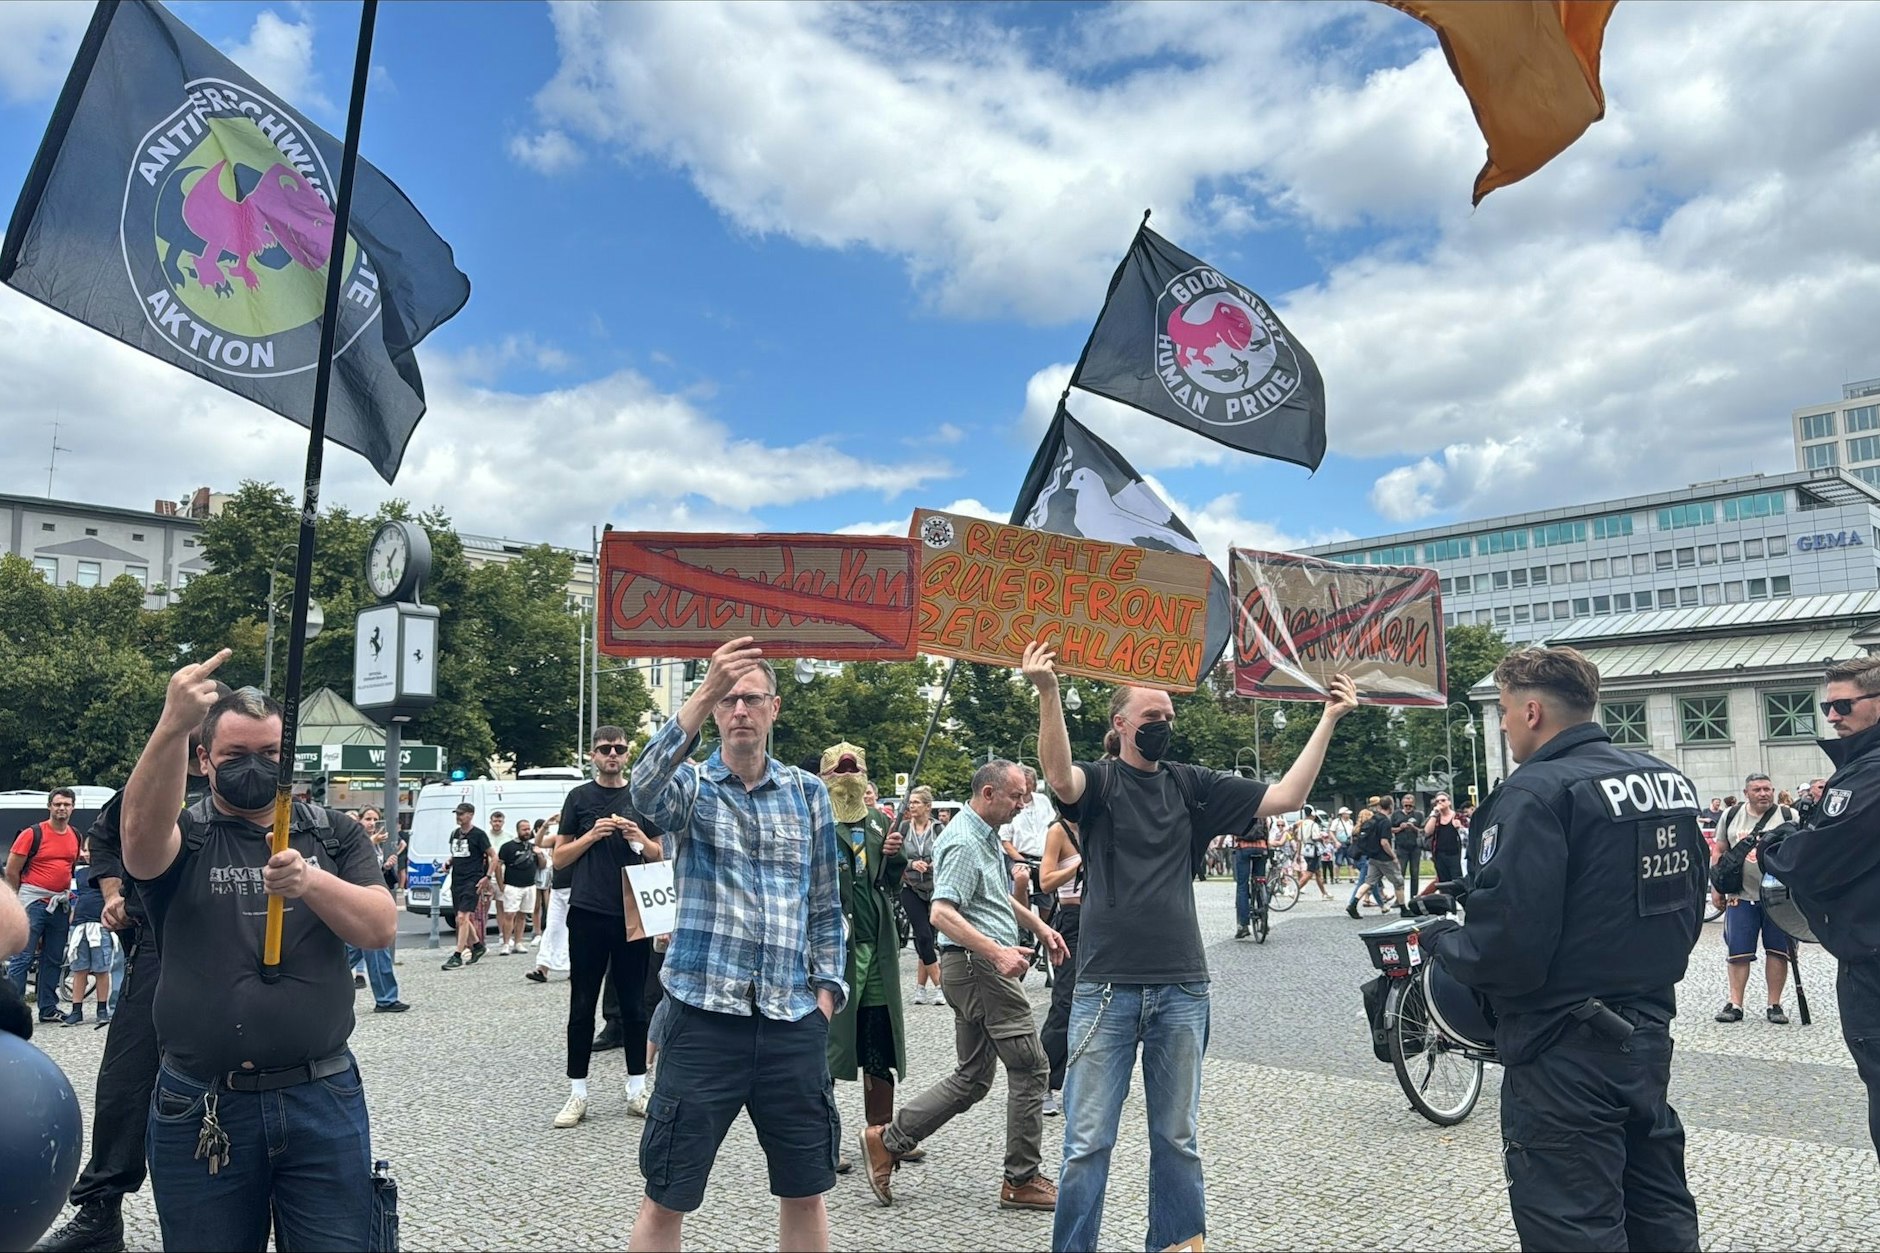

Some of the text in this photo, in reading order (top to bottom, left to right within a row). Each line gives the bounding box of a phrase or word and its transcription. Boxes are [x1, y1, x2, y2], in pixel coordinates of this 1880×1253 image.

[1170, 270, 1228, 305] GOOD
[146, 288, 275, 368] AKTION
[1158, 333, 1296, 420] HUMAN PRIDE
[965, 521, 1146, 582] RECHTE
[1796, 530, 1864, 552] GEMA
[921, 553, 1205, 638] QUERFRONT
[919, 600, 1205, 687] ZERSCHLAGEN
[1600, 772, 1699, 817] POLIZEI
[1656, 824, 1677, 850] BE
[1641, 849, 1690, 879] 32123
[1379, 946, 1397, 954] FCK
